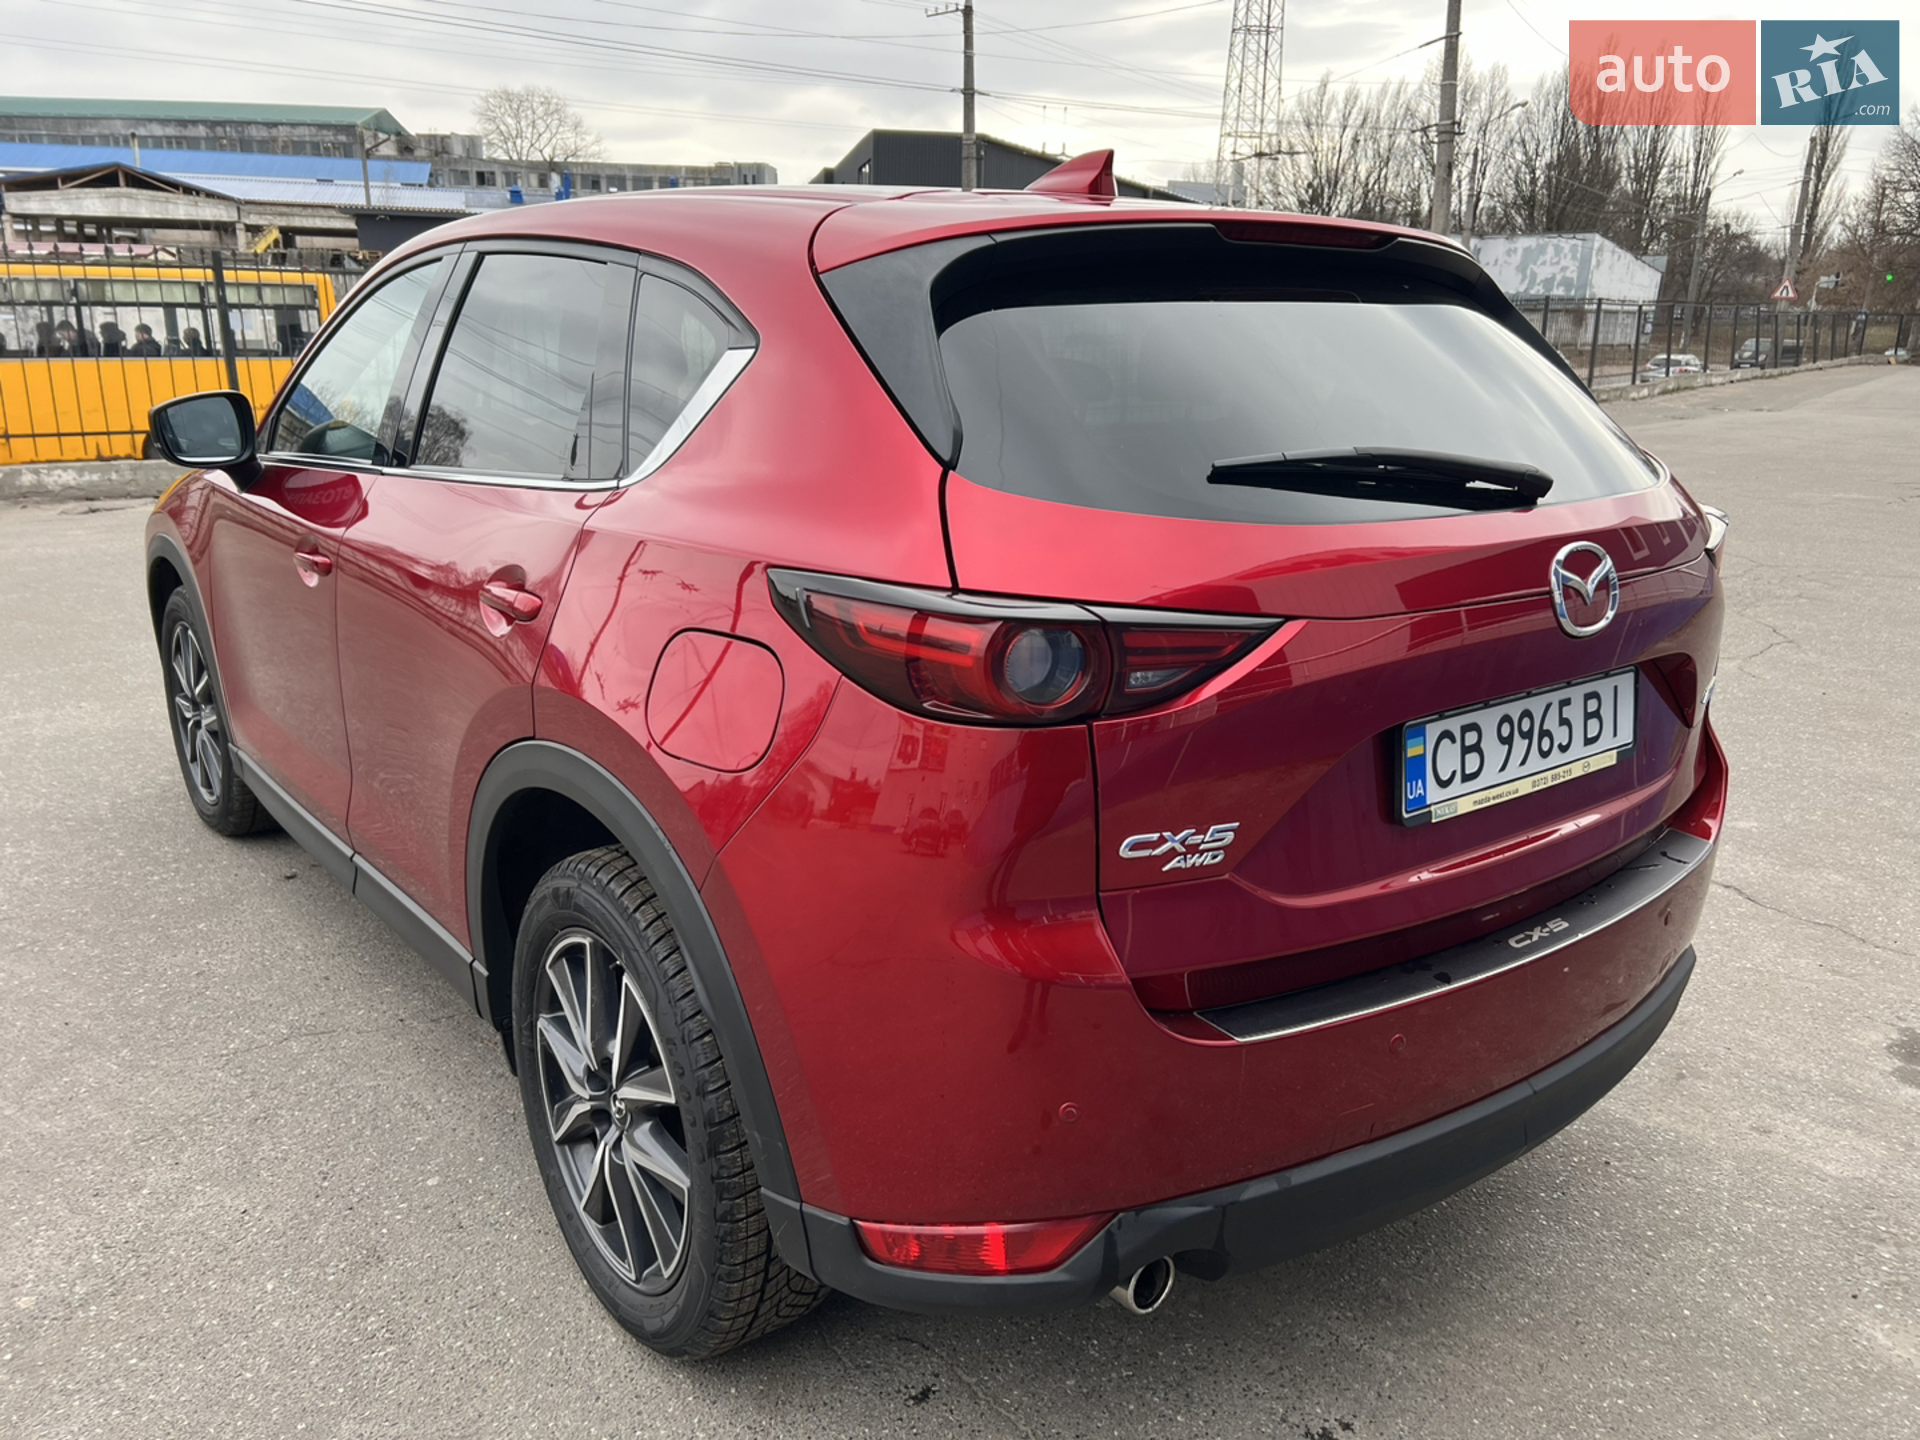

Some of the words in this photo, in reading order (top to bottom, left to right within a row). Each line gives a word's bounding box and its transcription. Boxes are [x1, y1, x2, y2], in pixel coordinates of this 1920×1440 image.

[1431, 721, 1485, 789] CB
[1496, 696, 1574, 774] 9965
[1583, 684, 1619, 747] BI
[1407, 779, 1425, 800] UA
[1119, 822, 1240, 859] CX-5
[1161, 850, 1225, 872] AWD
[1508, 917, 1570, 949] CX-5
